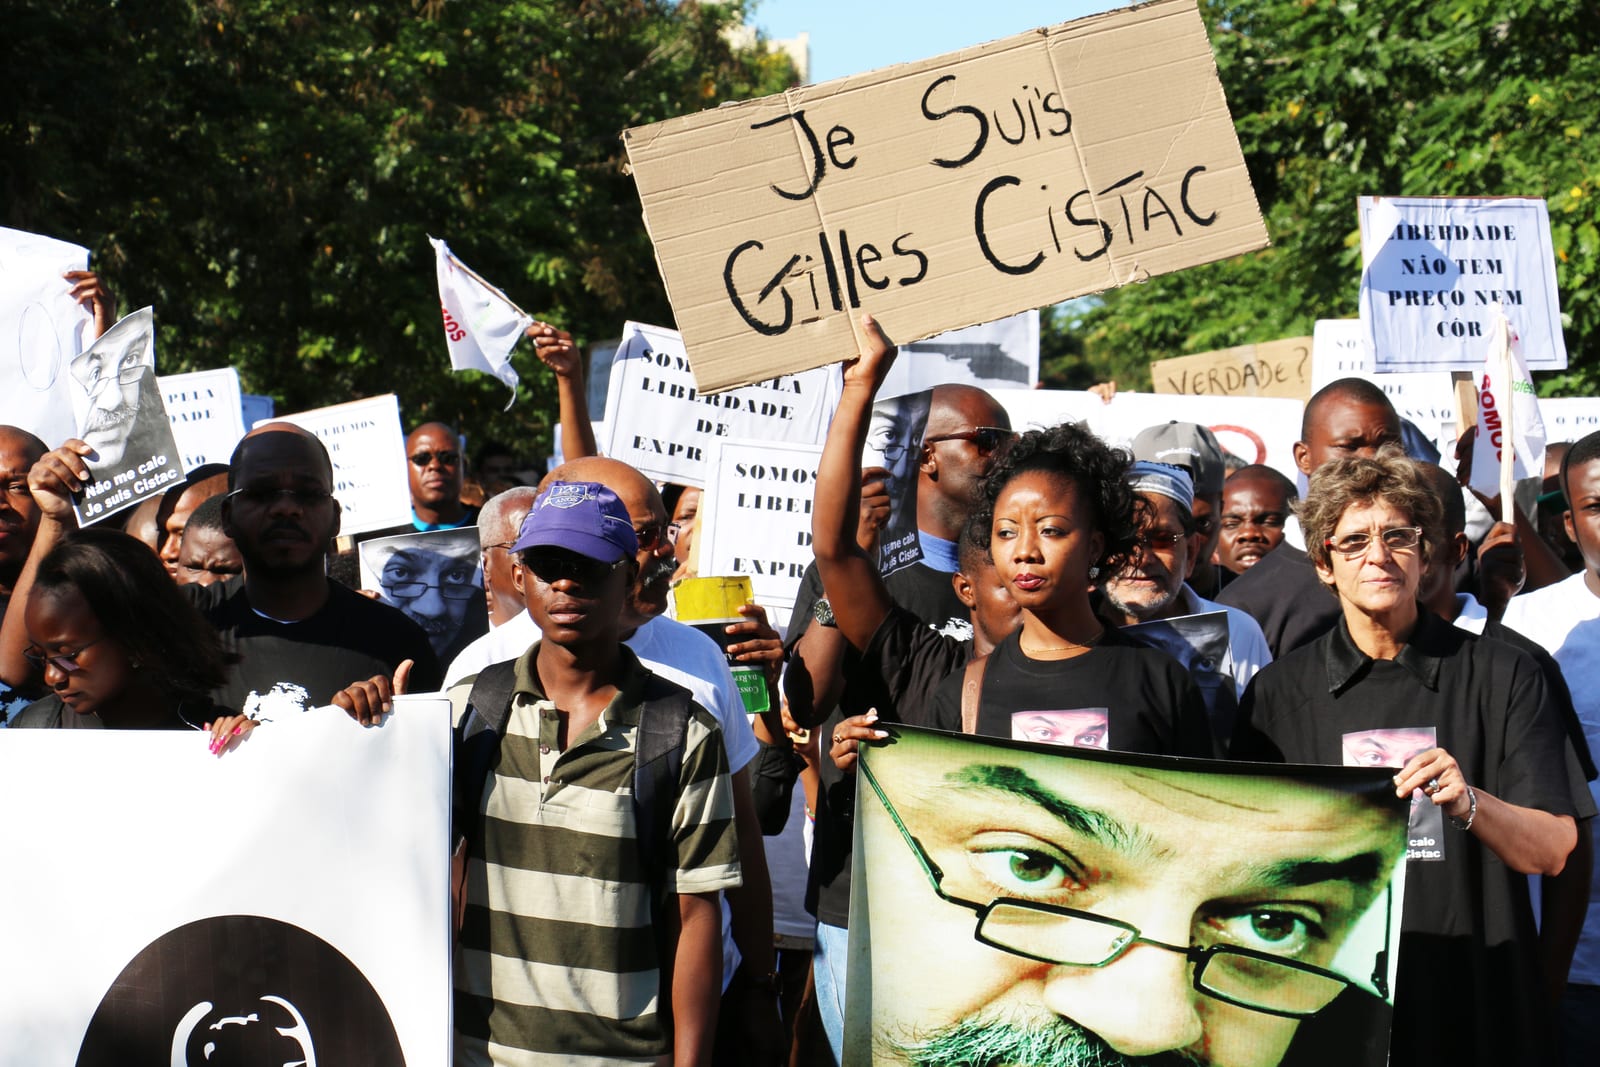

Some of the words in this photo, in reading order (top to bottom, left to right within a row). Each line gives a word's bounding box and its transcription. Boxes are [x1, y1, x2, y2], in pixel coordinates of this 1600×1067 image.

[750, 110, 857, 200] Je
[920, 75, 1072, 168] Suis
[1401, 254, 1447, 275] NÃO
[1455, 258, 1503, 275] TEM
[725, 229, 928, 336] Gilles
[1388, 289, 1465, 310] PREÇO
[1474, 289, 1524, 306] NEM
[1436, 317, 1482, 337] CÓR
[641, 348, 691, 373] SOM
[696, 418, 730, 437] DE
[1575, 416, 1598, 425] PO
[633, 435, 703, 462] EXPR
[85, 480, 112, 499] Não
[113, 470, 136, 486] me
[138, 455, 167, 475] calo
[85, 502, 103, 517] Je
[104, 489, 132, 508] suis
[134, 469, 178, 494] Cistac
[898, 548, 919, 562] Cistac
[733, 557, 804, 579] EXPR
[1409, 837, 1435, 847] calo
